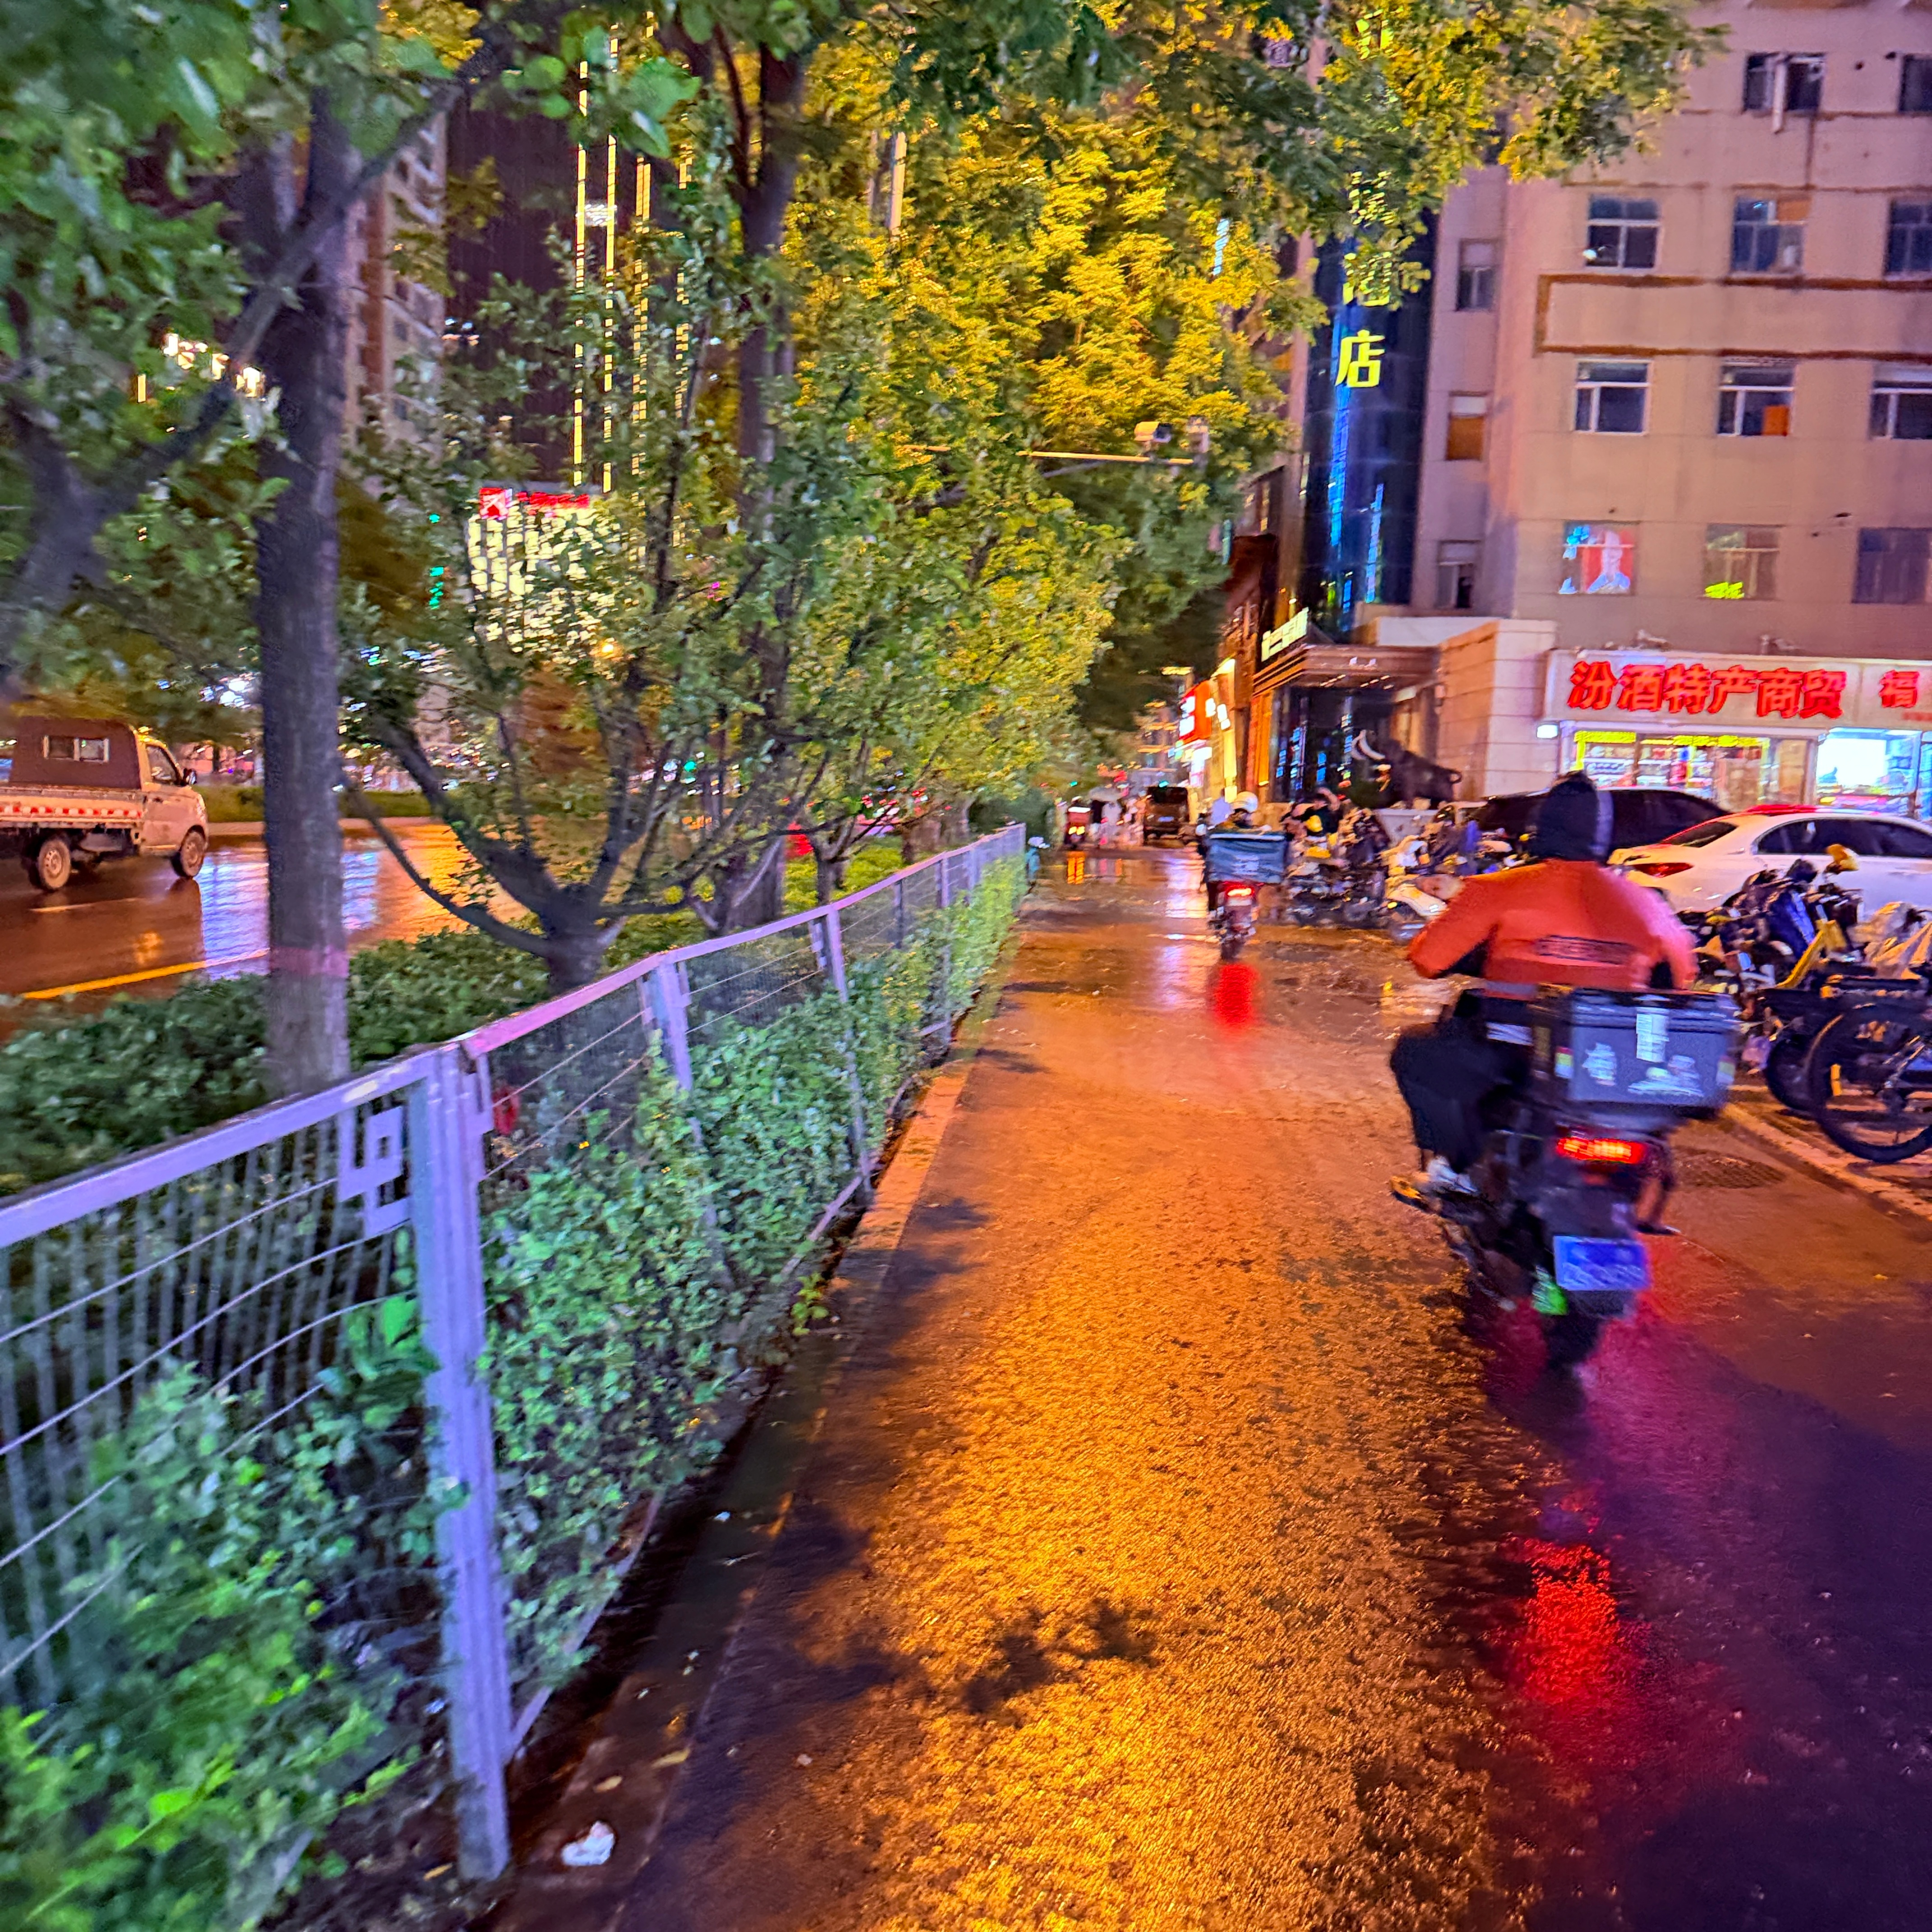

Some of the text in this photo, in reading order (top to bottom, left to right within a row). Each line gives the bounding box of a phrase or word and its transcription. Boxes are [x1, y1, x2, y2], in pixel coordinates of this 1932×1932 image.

[1567, 660, 1847, 719] 汾酒特产商贸
